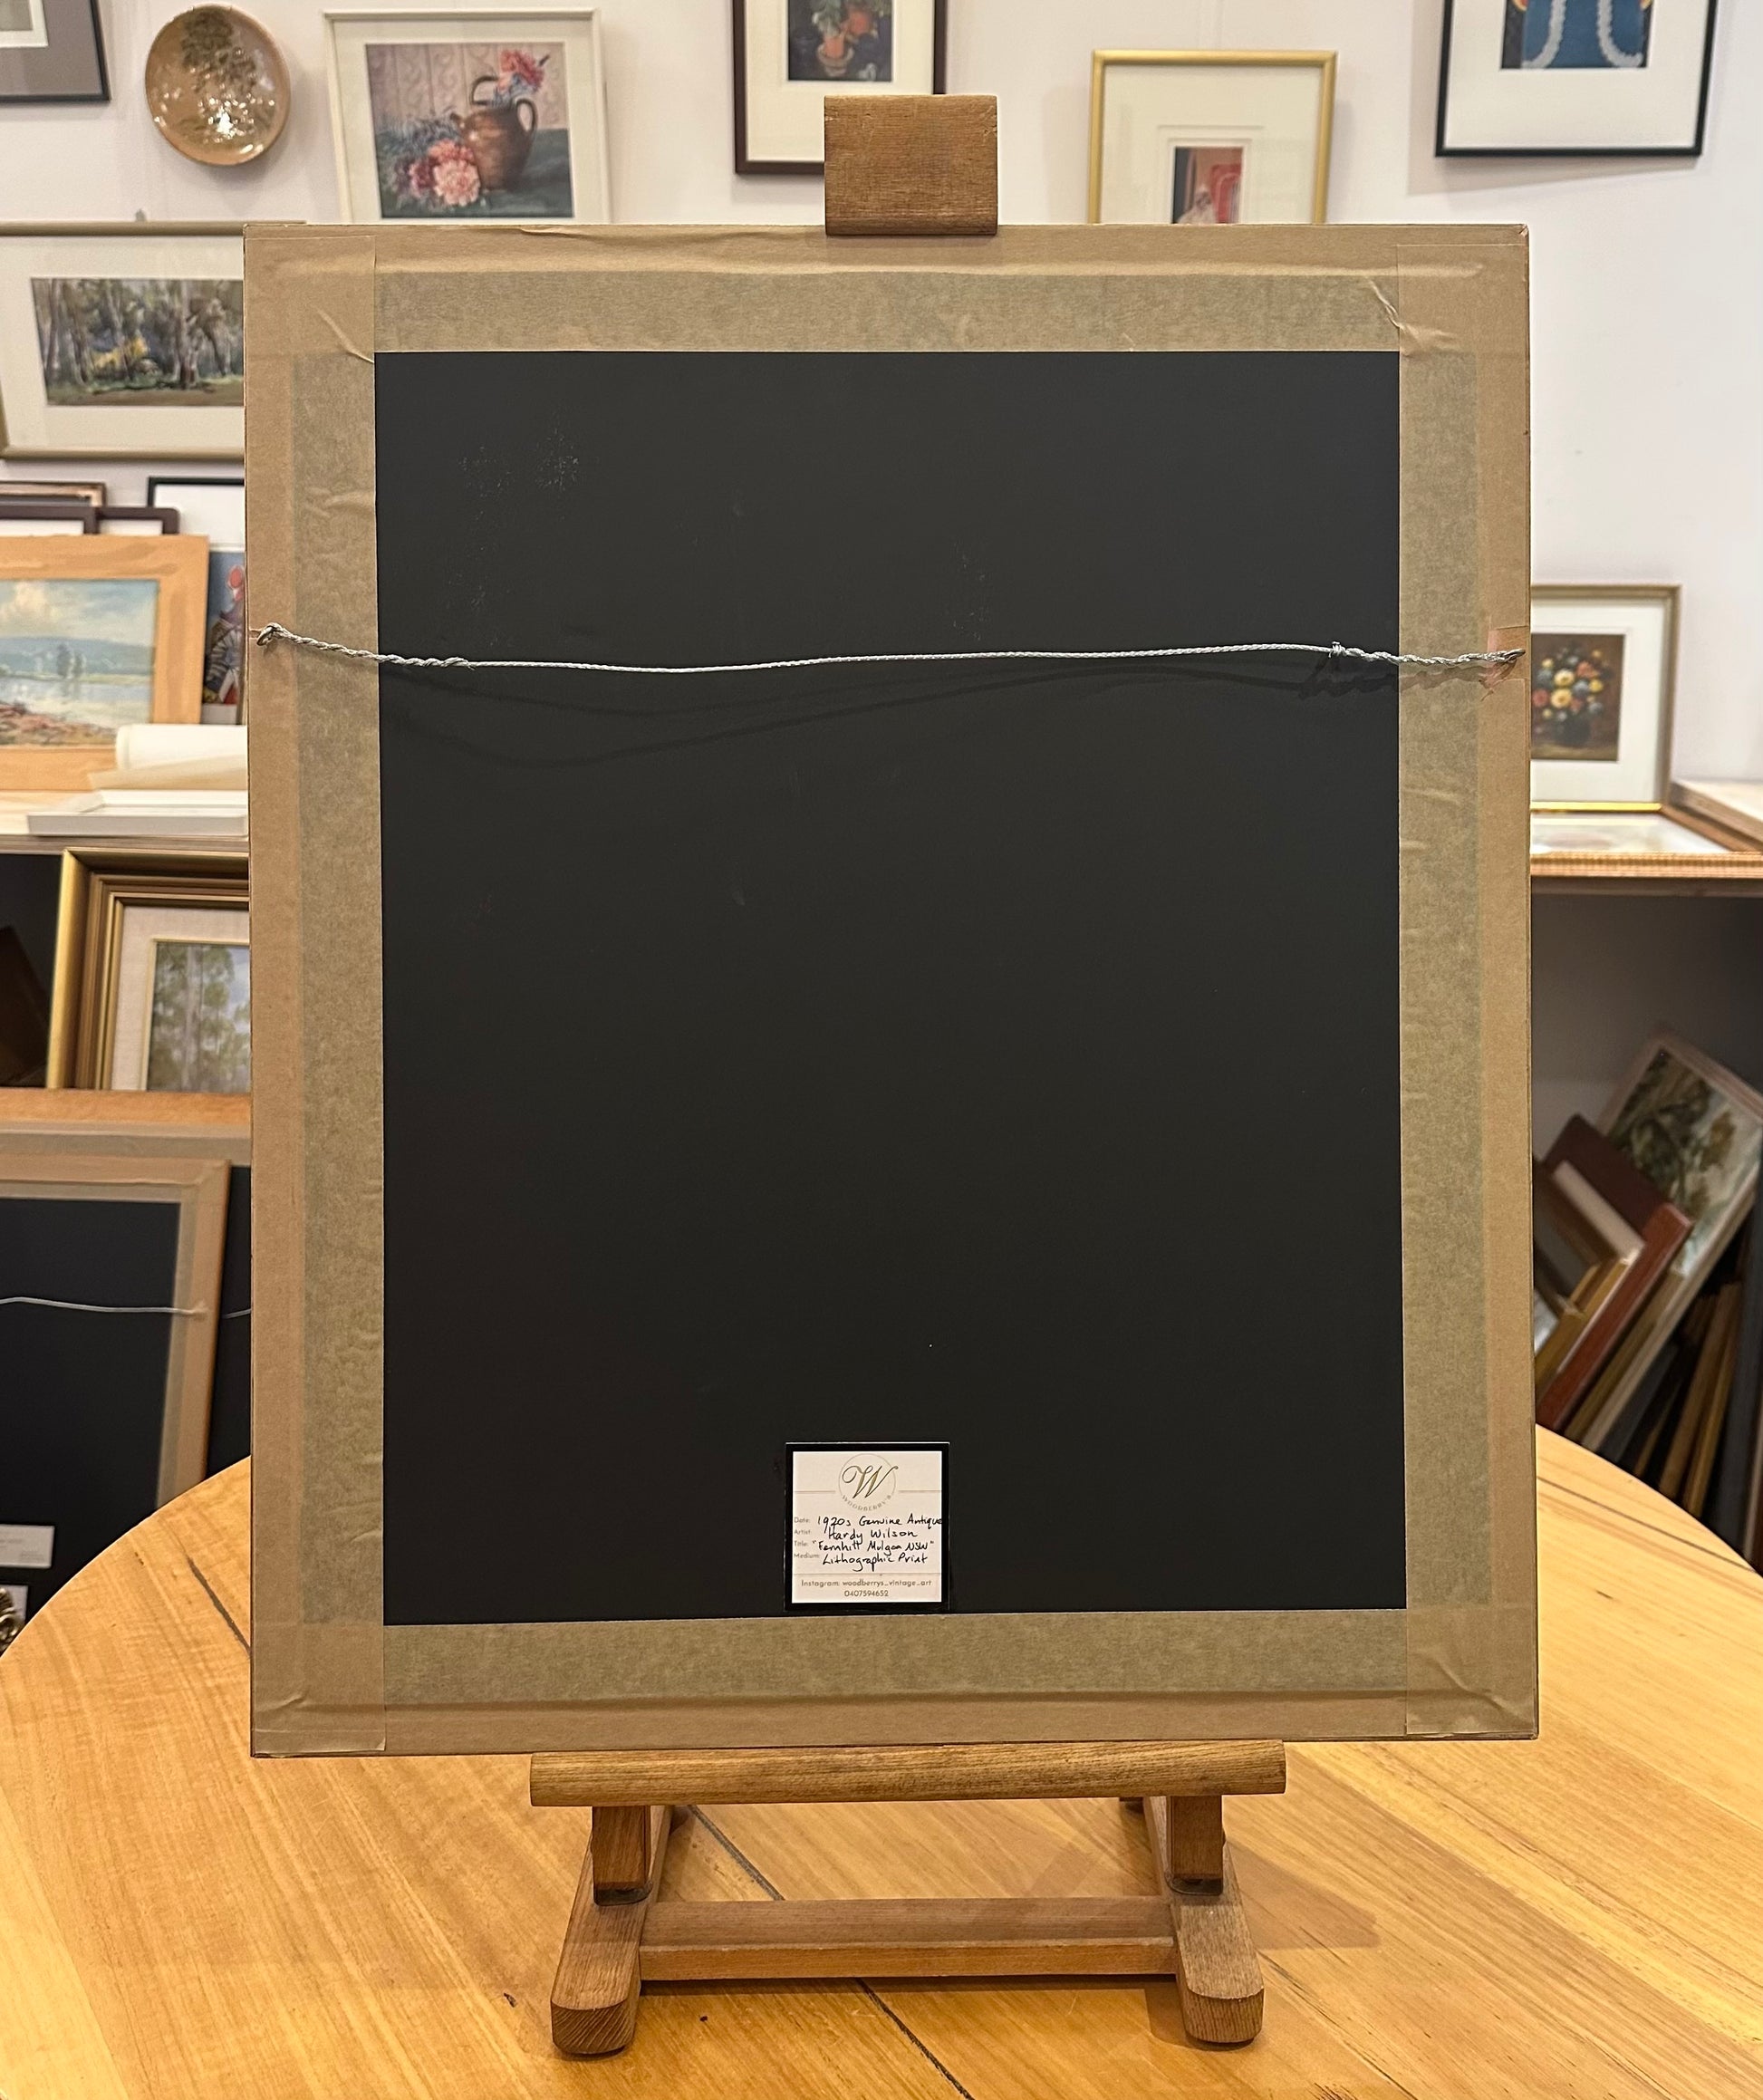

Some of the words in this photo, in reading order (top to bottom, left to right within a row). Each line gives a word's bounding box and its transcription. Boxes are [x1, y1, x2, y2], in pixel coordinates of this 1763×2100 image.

[842, 1465, 899, 1499] W
[817, 1516, 852, 1534] 1920s
[858, 1516, 902, 1527] Genuine
[907, 1512, 942, 1529] Antique
[828, 1526, 863, 1545] Hardy
[871, 1527, 918, 1538] Wilson
[822, 1552, 895, 1572] Lithographic
[898, 1552, 929, 1564] Print
[843, 1589, 890, 1597] 0407594652
